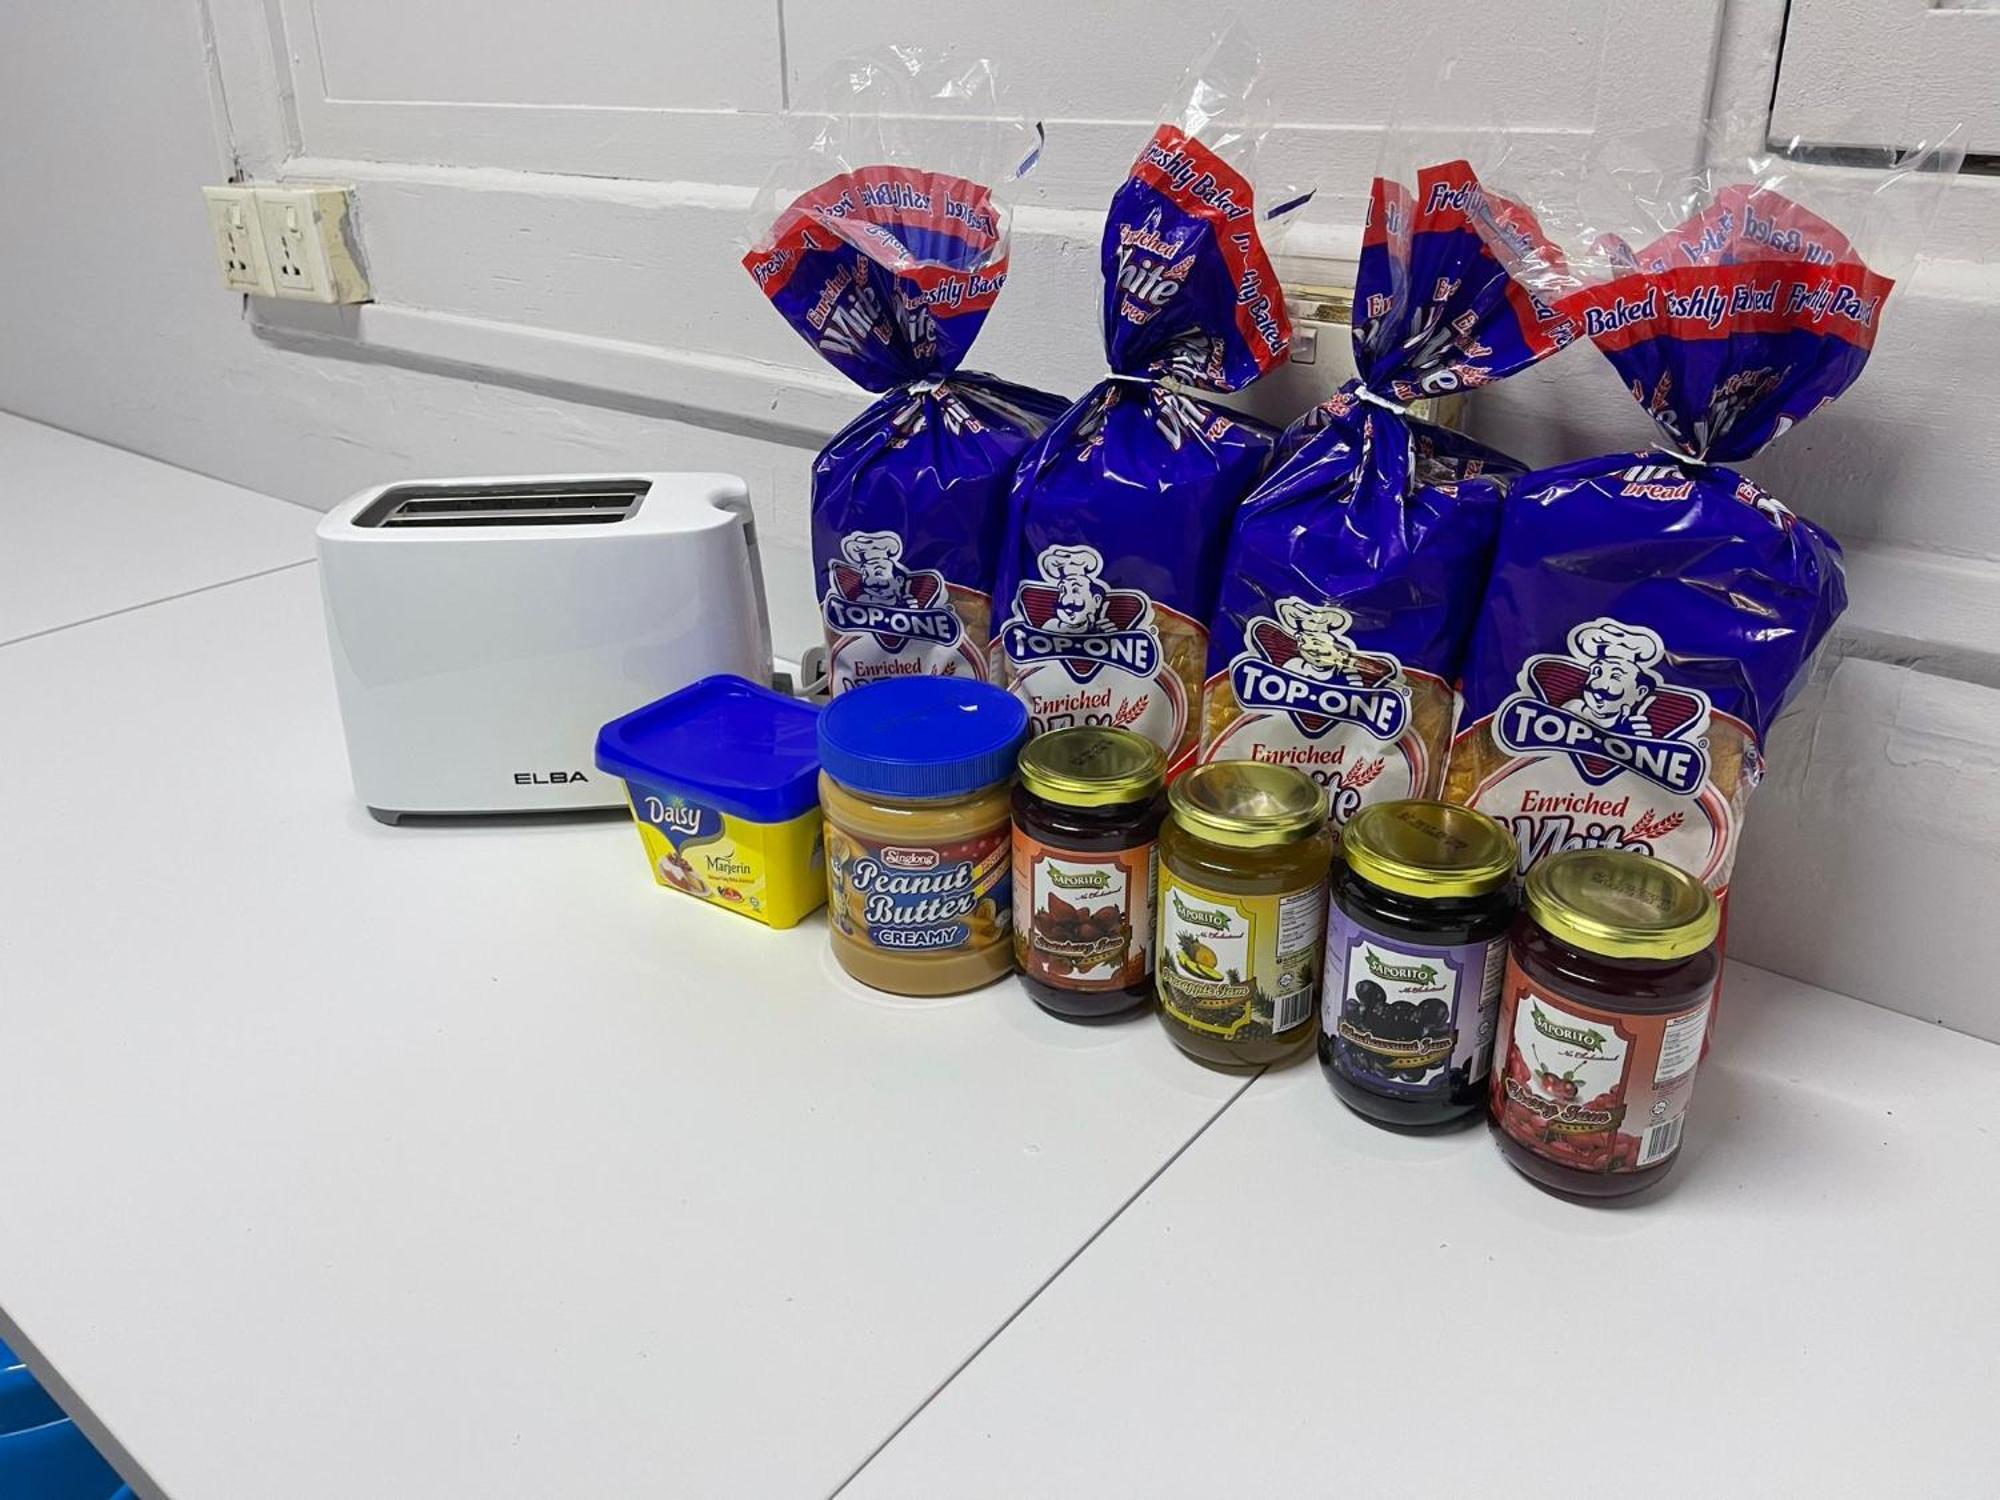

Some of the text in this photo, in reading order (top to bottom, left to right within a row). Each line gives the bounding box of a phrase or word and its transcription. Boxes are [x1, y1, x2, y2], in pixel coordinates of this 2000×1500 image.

[1191, 173, 1251, 221] Baked
[1249, 291, 1290, 357] Baked
[1585, 285, 1658, 337] Baked
[854, 657, 922, 677] Enriched
[1032, 687, 1112, 715] Enriched
[1250, 742, 1346, 765] Enriched
[514, 771, 589, 785] ELBA
[645, 796, 701, 835] Daisy
[1520, 789, 1631, 818] Enriched
[705, 849, 751, 875] Marjerin
[853, 860, 969, 894] Peanut
[866, 892, 973, 924] Butter
[879, 926, 958, 945] CREAMY
[1371, 961, 1428, 980] SAPORITO
[1535, 1017, 1595, 1045] SAPORITO
